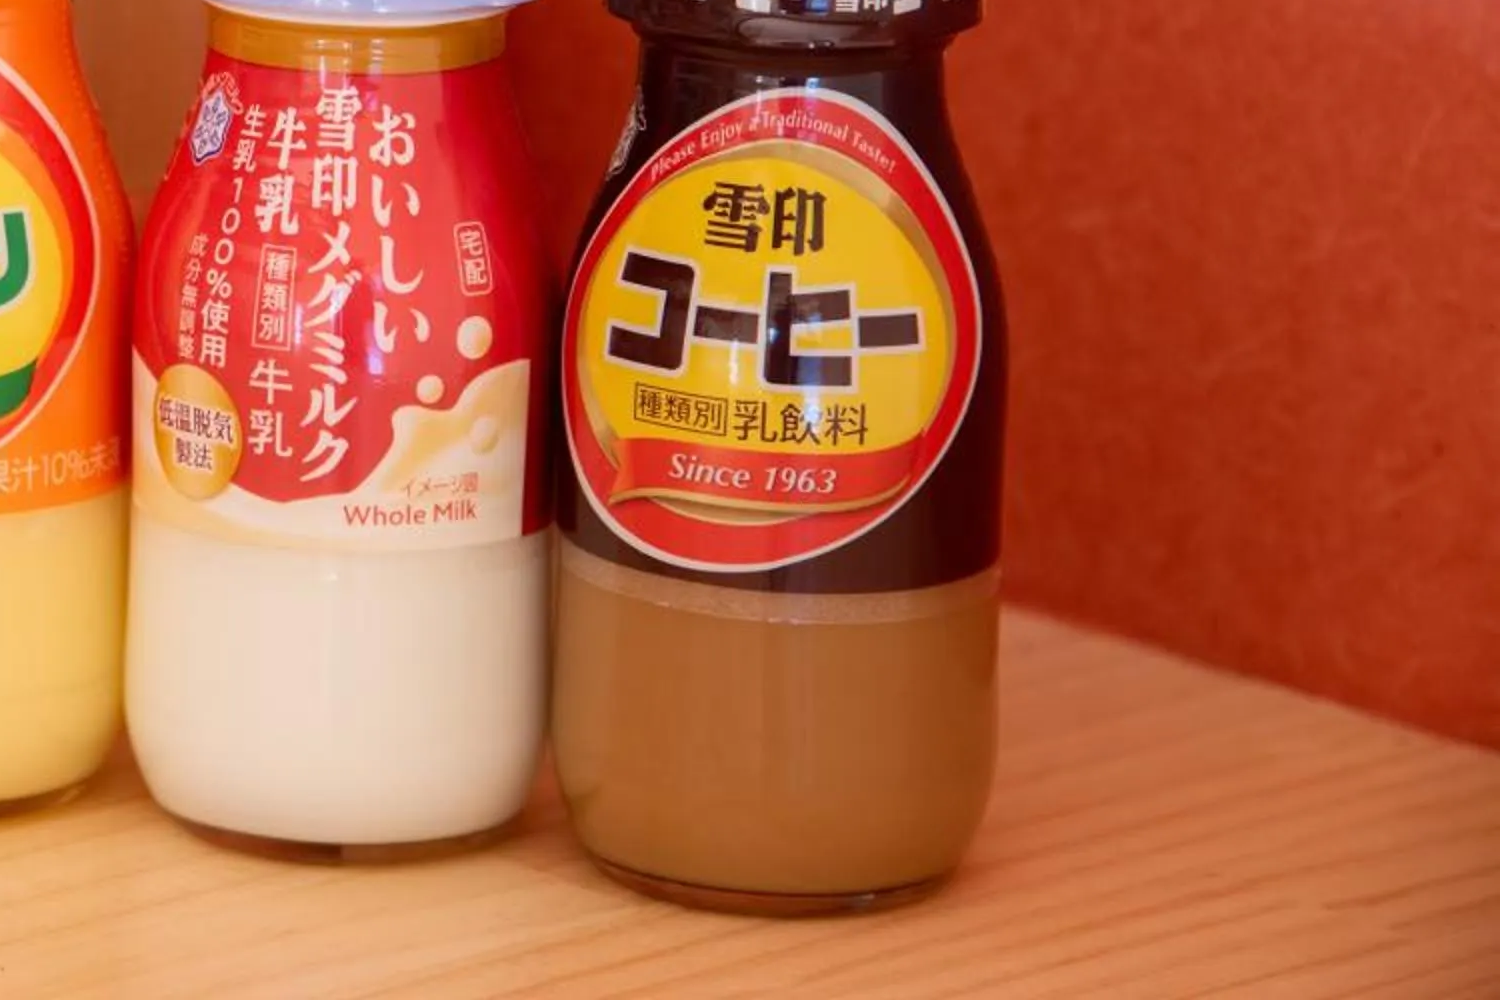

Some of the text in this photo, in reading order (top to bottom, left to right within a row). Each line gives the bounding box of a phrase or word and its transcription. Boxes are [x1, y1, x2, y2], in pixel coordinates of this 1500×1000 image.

[650, 141, 697, 181] Please
[700, 121, 744, 151] Enjoy
[760, 109, 850, 143] Traditional
[851, 130, 897, 174] Taste!
[368, 106, 431, 354] おいしい
[702, 180, 828, 257] 雪印
[247, 106, 308, 458] 牛乳 種類別 牛乳
[299, 87, 363, 483] 雪印メグミルク
[458, 226, 488, 286] 宅配
[606, 249, 923, 389] コーヒー
[637, 386, 868, 447] 種類別 乳飲料
[668, 453, 838, 495] Since 1963
[343, 498, 478, 527] Whole Milk
